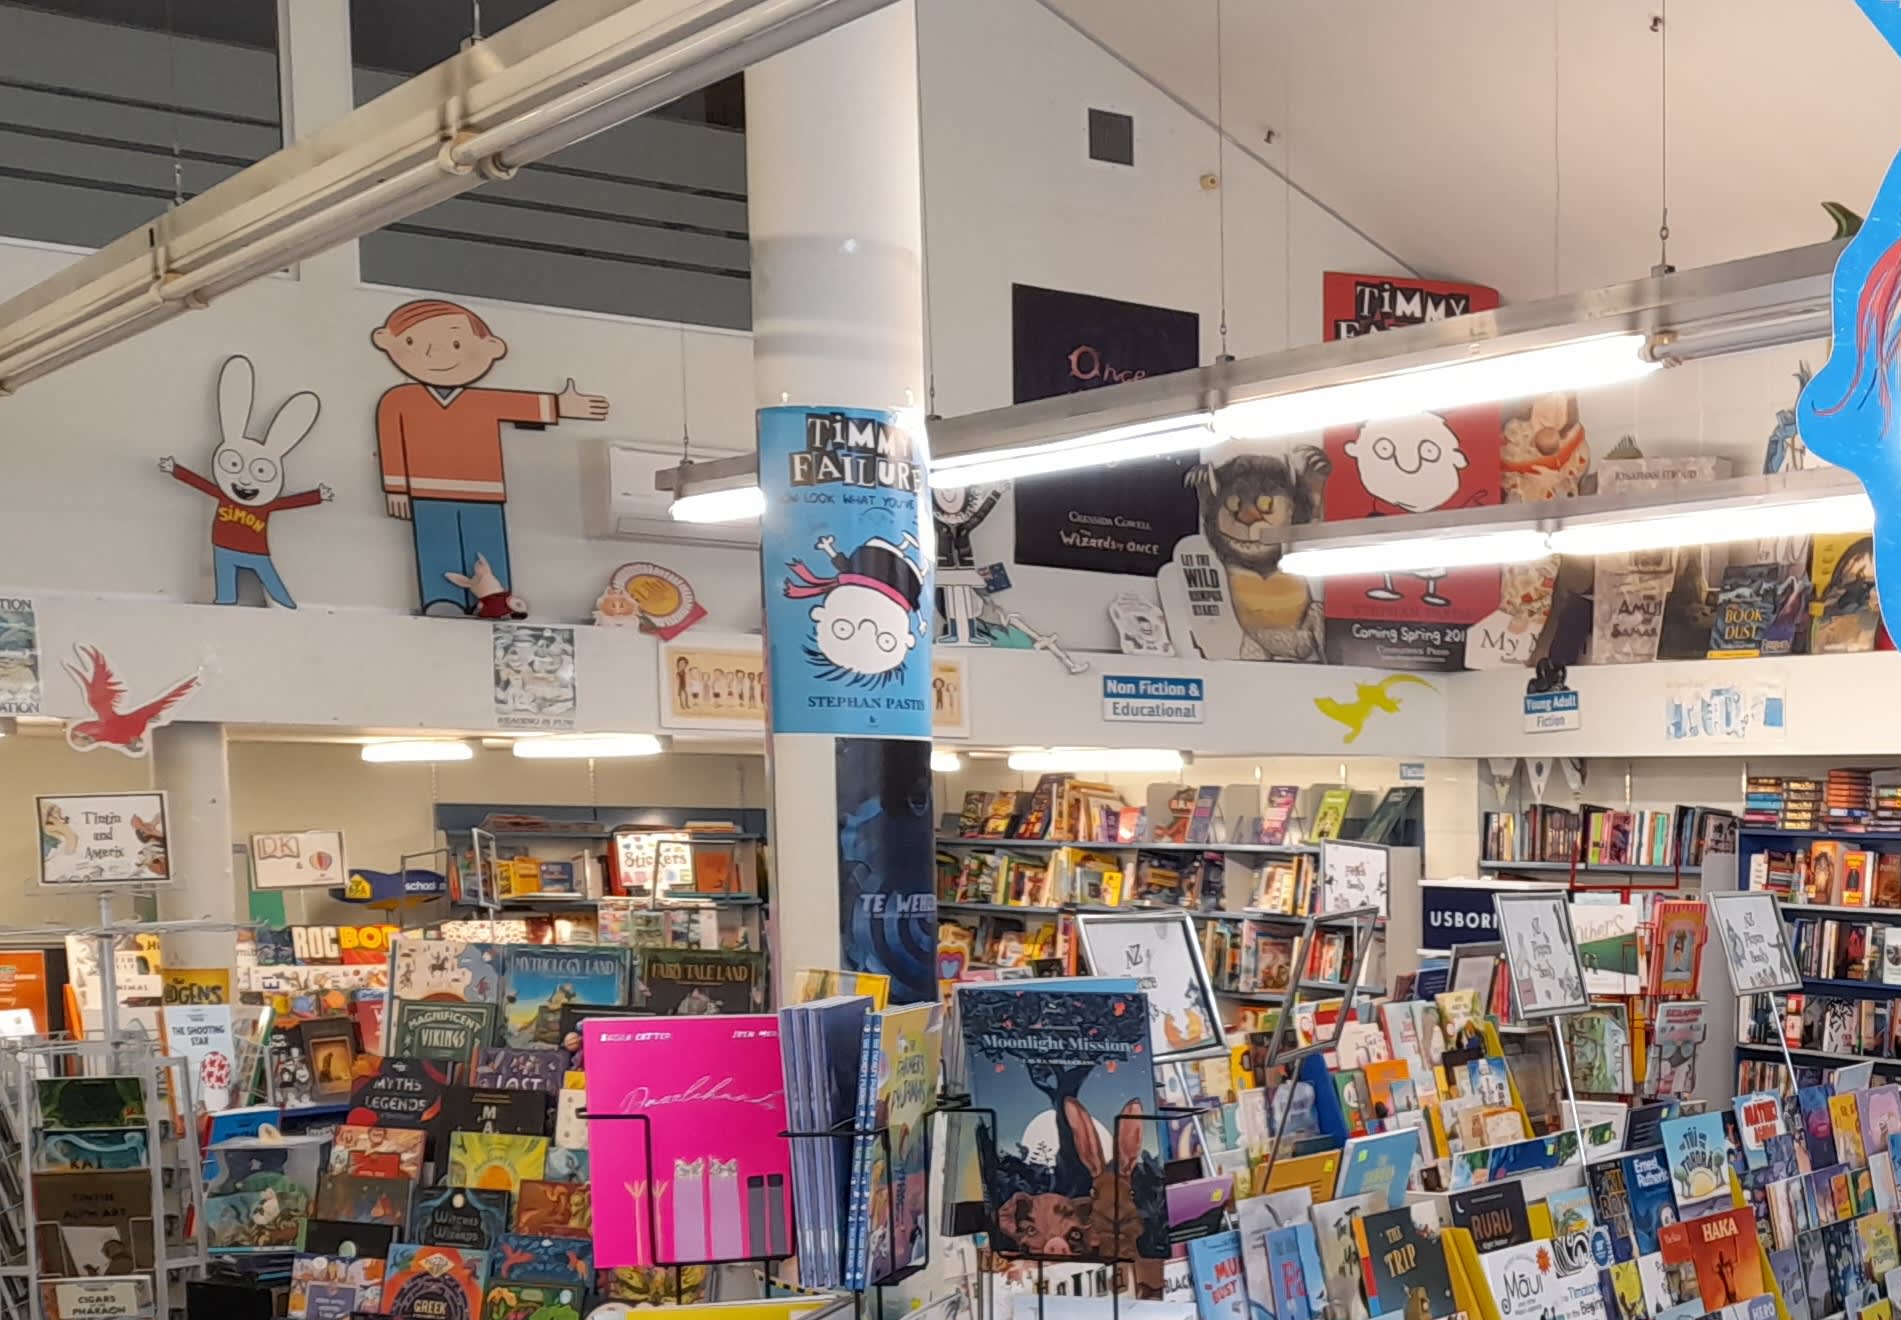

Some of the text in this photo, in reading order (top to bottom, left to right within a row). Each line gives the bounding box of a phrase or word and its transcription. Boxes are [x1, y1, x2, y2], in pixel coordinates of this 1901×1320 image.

[790, 452, 923, 492] FAILURE
[1184, 567, 1220, 589] WILD
[1725, 606, 1763, 623] BOOK
[1352, 624, 1441, 645] Coming Spring
[1724, 623, 1760, 641] DUST
[1107, 679, 1200, 697] Non Fiction &
[808, 695, 882, 710] STEPHAN
[1112, 701, 1197, 720] Educational
[1537, 714, 1566, 728] Fiction
[81, 811, 122, 825] Tintin
[623, 851, 689, 869] Stickers
[860, 893, 886, 913] TE
[584, 958, 615, 976] LAND
[188, 1023, 225, 1035] SHOOTING
[408, 1009, 482, 1034] MAGNIFICENT
[421, 1028, 466, 1049] VIKINGS
[982, 1033, 1135, 1054] Moonlight Mission
[373, 1077, 423, 1092] MYTHS
[365, 1095, 427, 1111] LEGENDS
[1701, 1216, 1739, 1243] HAKA
[1384, 1245, 1417, 1279] TRIP
[1501, 1272, 1544, 1315] Māui
[413, 1299, 447, 1315] GREEK
